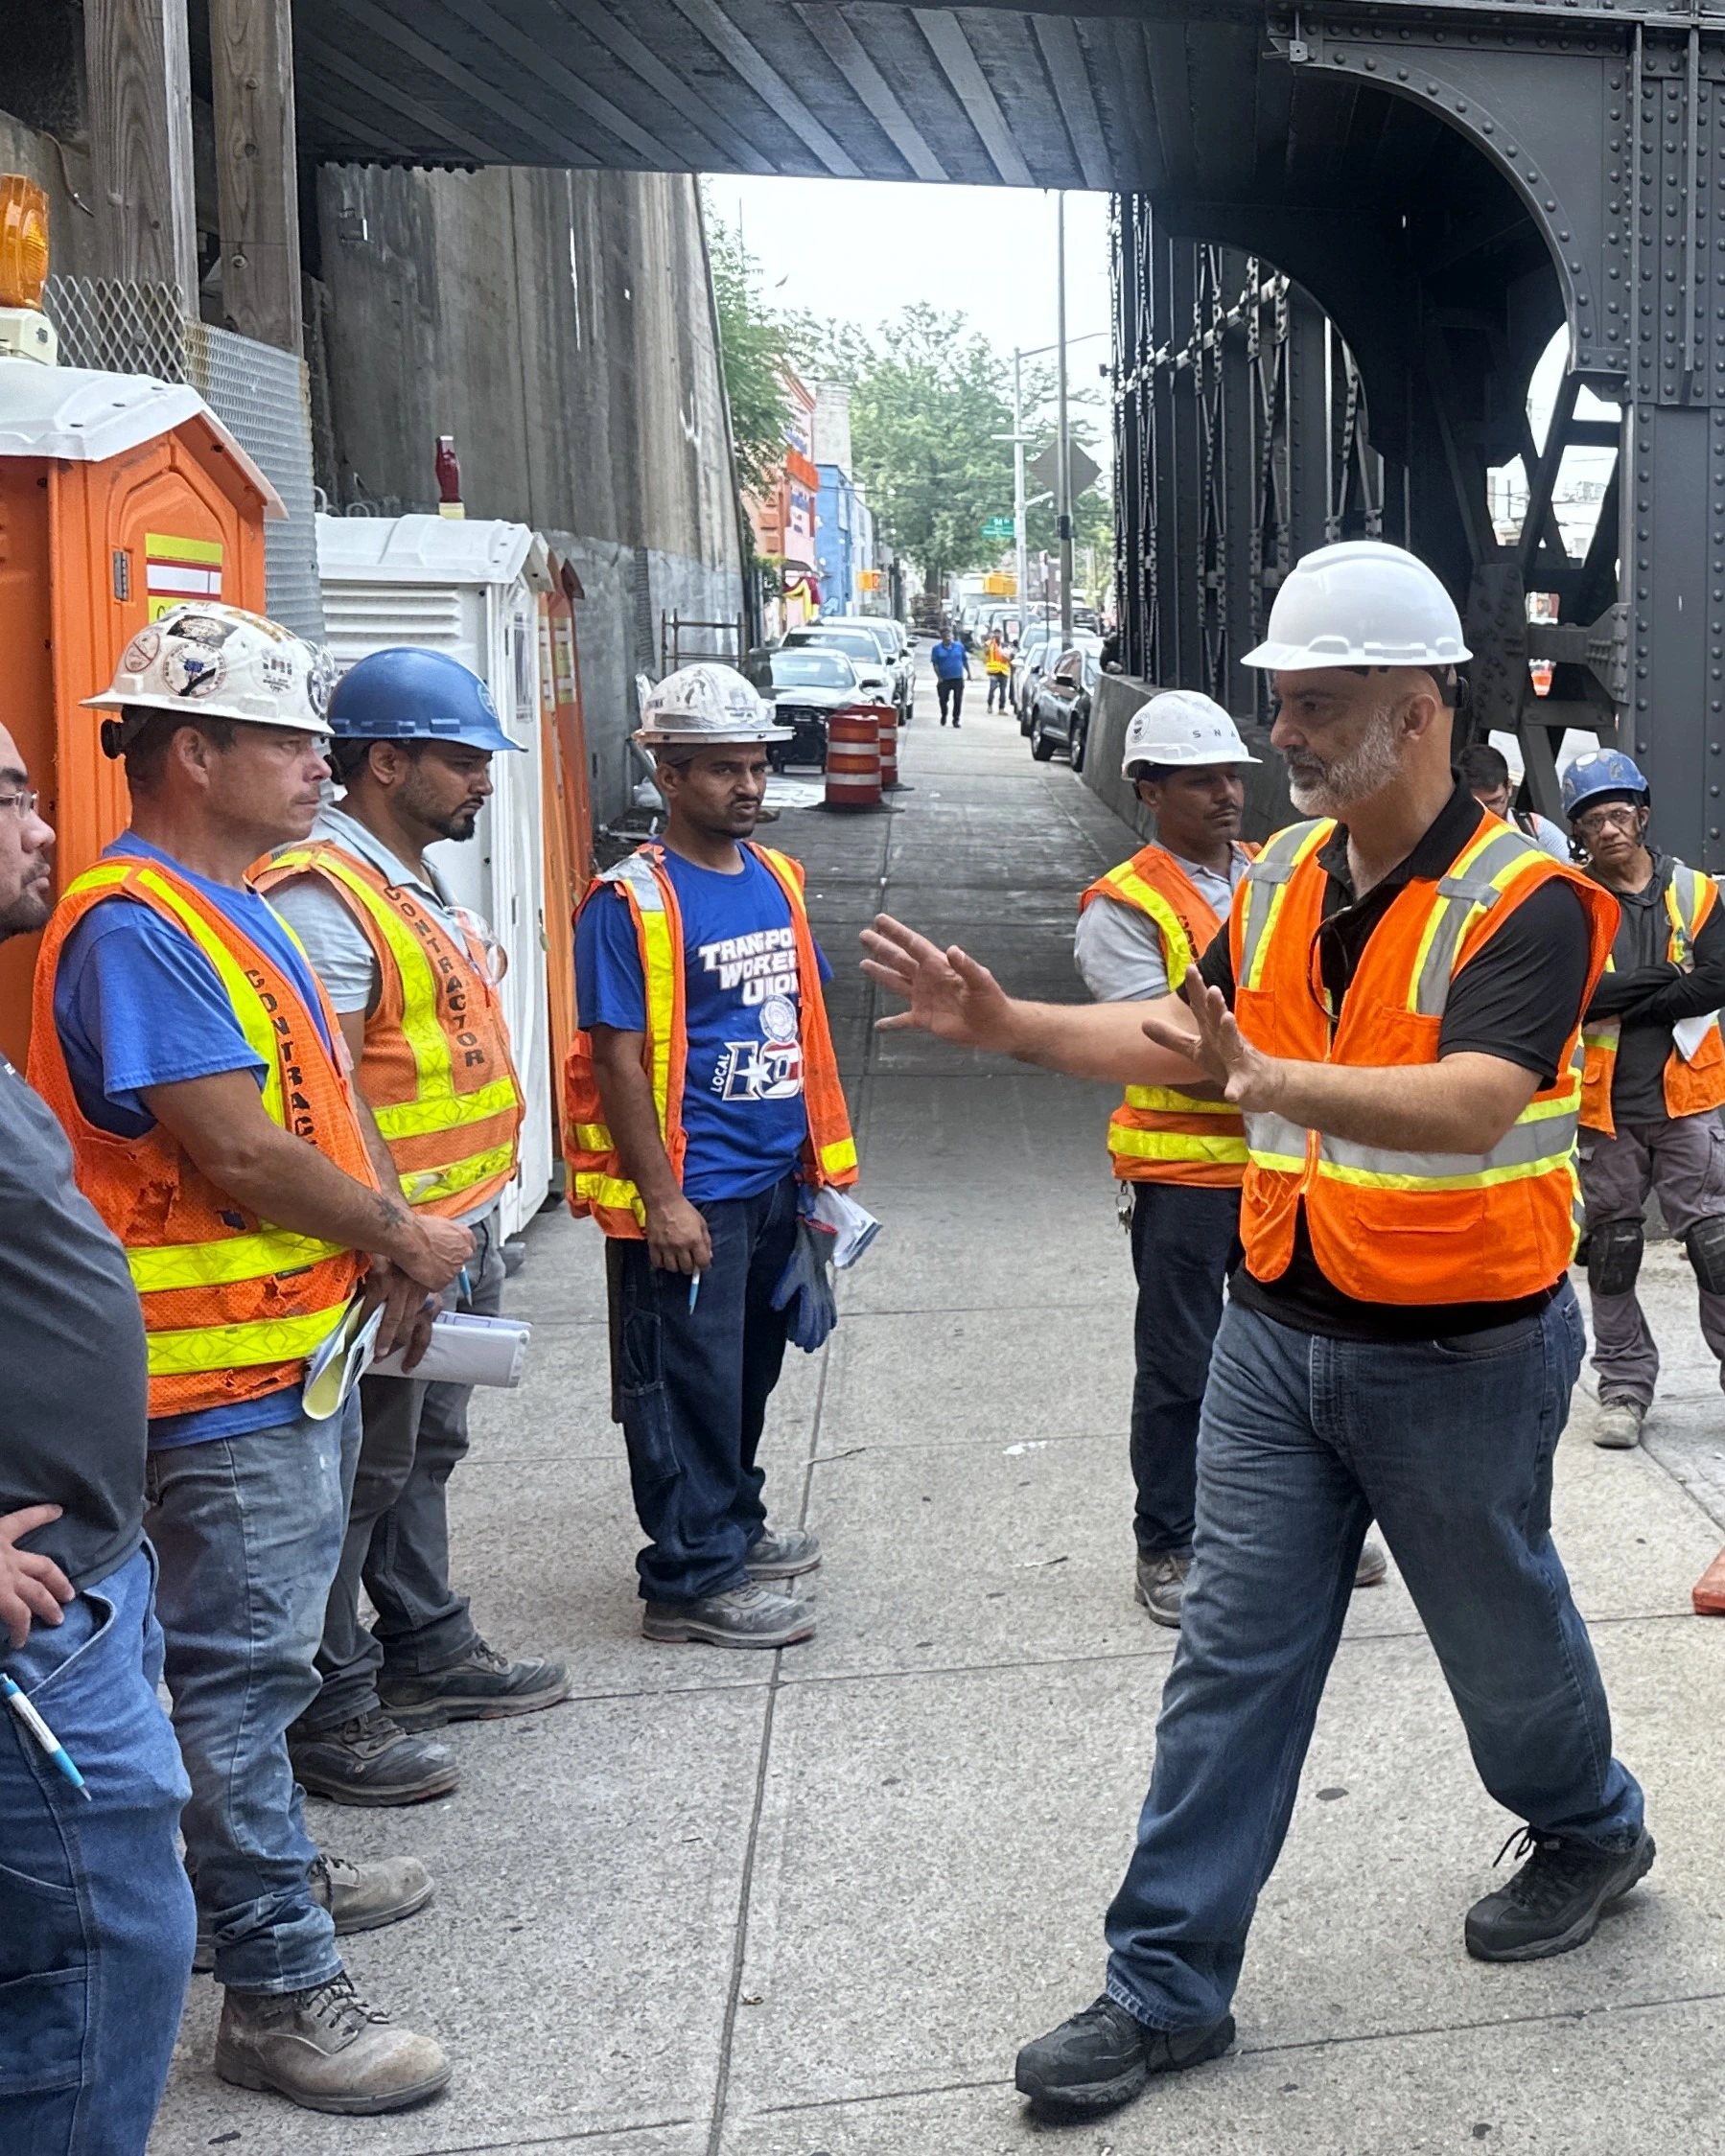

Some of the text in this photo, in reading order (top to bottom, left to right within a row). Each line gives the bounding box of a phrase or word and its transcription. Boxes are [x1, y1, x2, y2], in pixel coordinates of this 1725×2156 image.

[384, 887, 485, 1067] CONTRACTOR
[1177, 915, 1200, 962] CON
[245, 969, 317, 1145] CONTRAC
[710, 1054, 731, 1093] LOCAL
